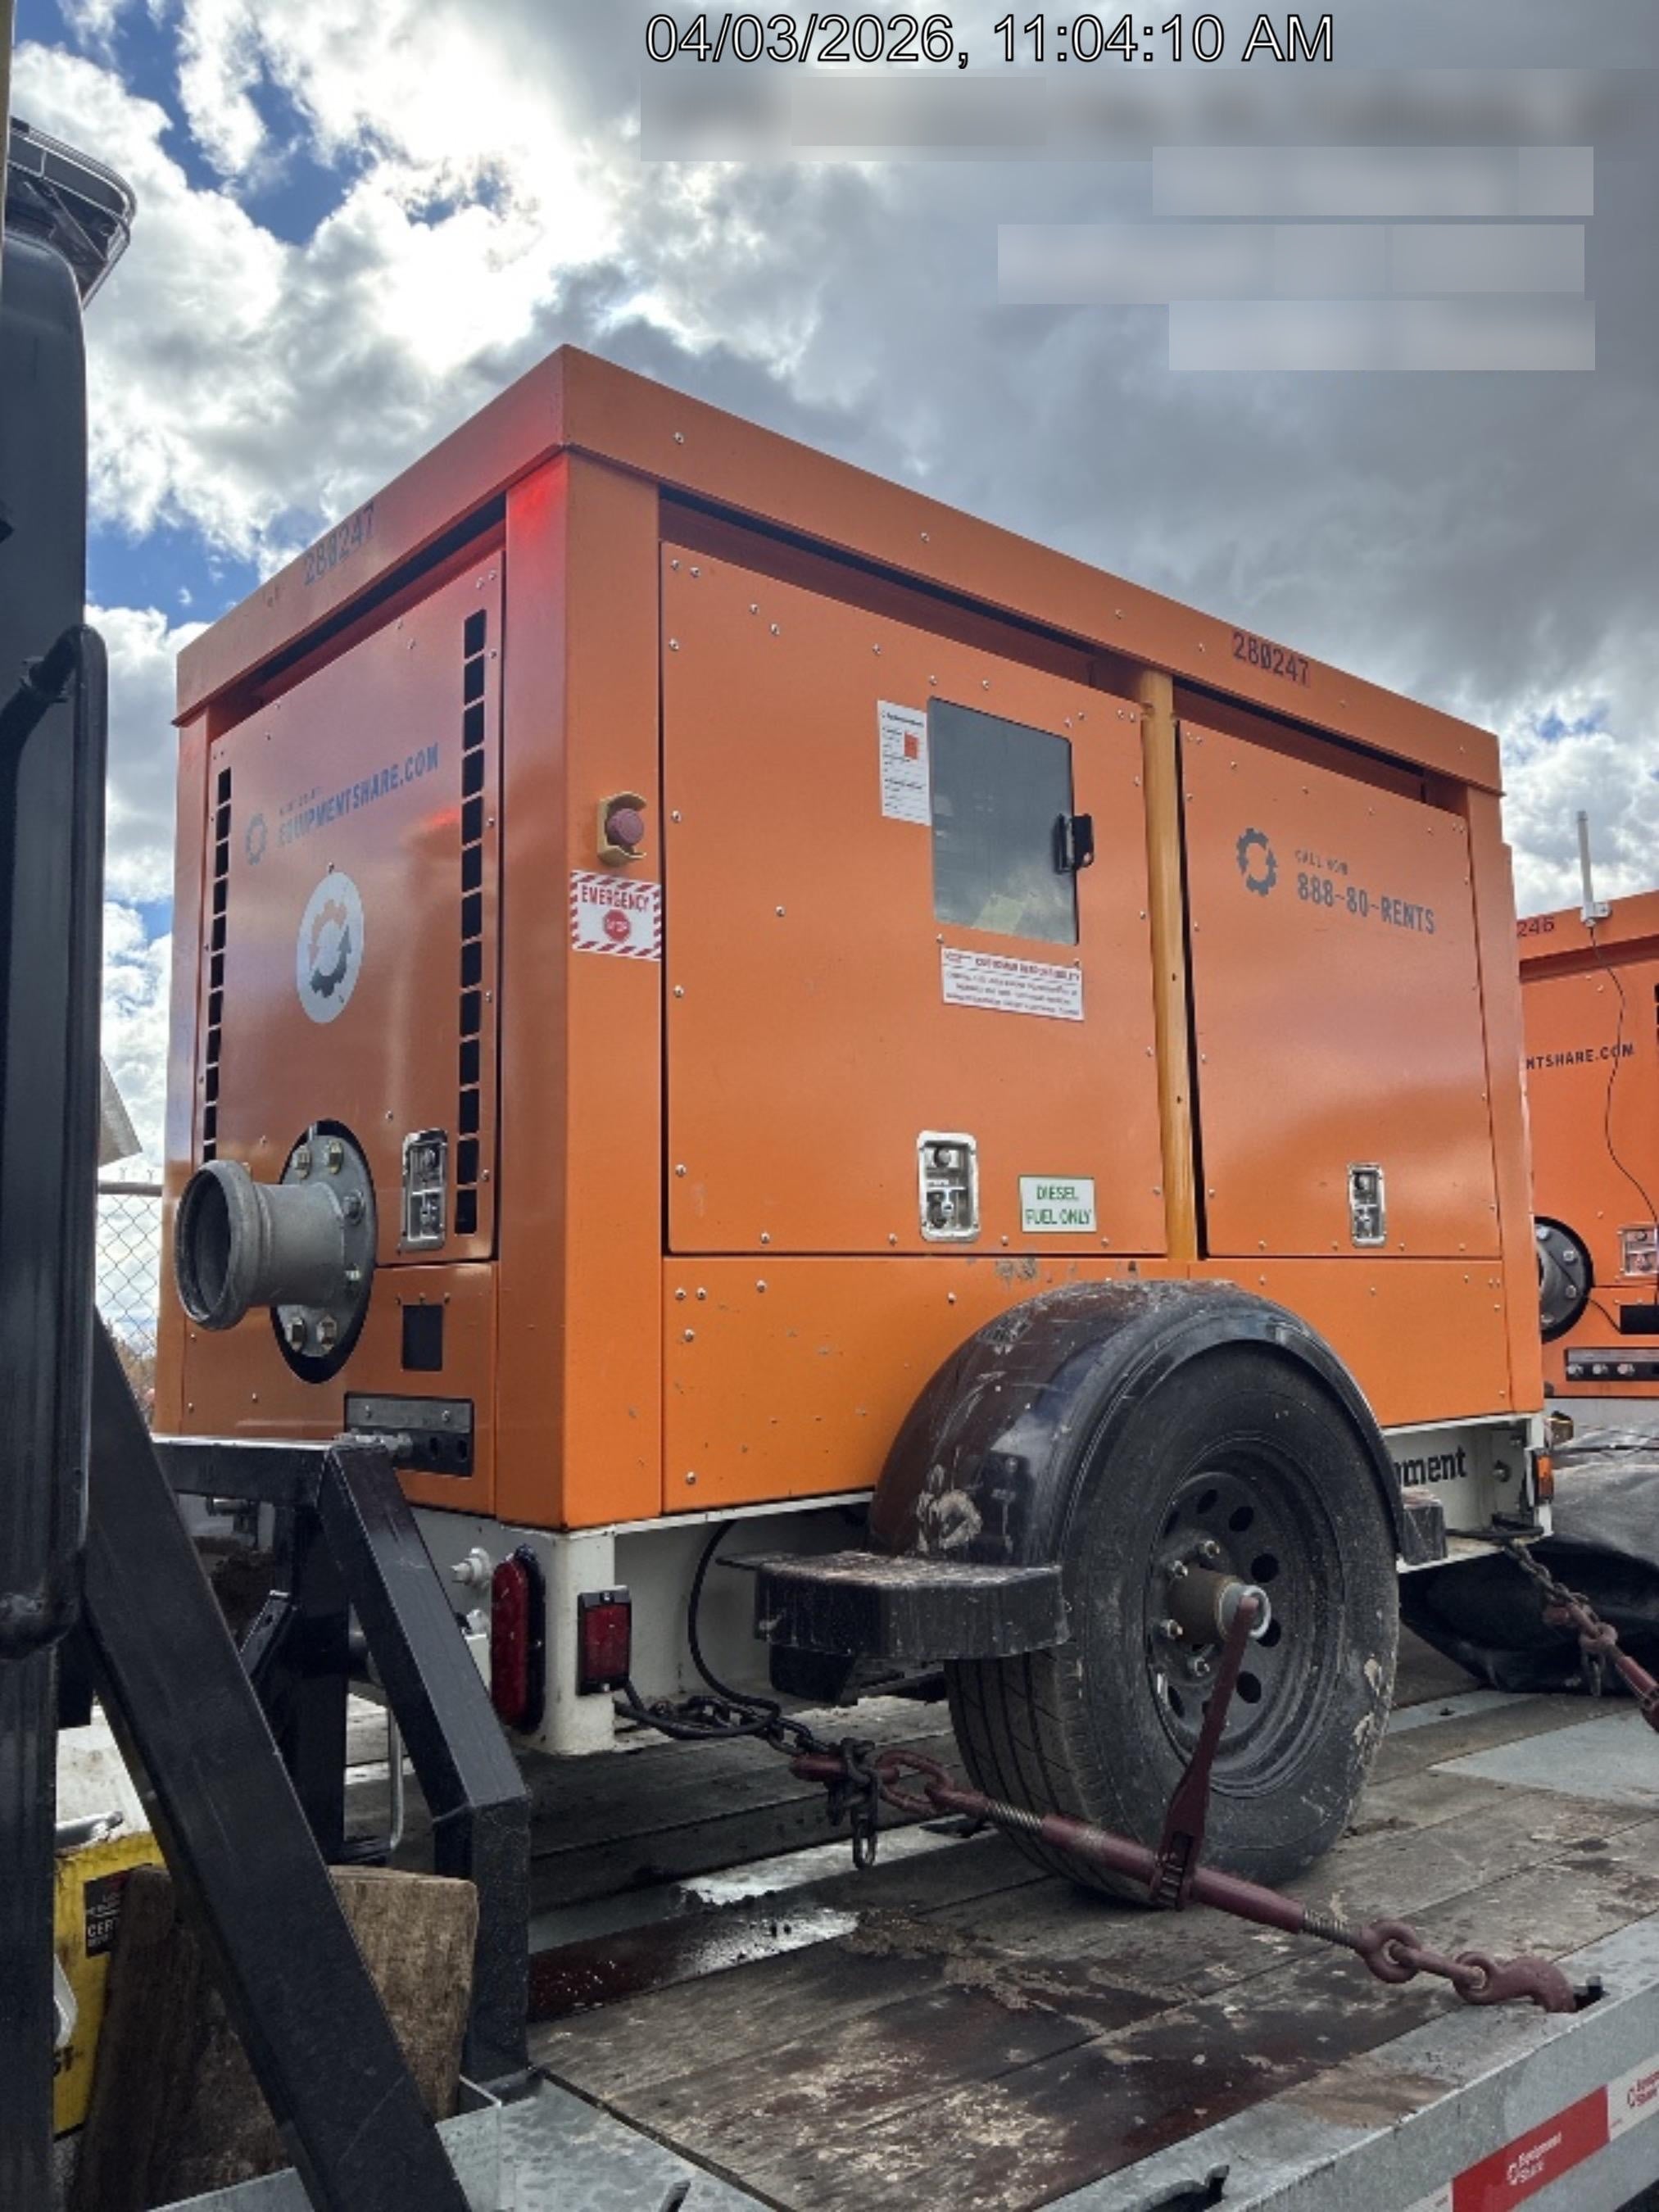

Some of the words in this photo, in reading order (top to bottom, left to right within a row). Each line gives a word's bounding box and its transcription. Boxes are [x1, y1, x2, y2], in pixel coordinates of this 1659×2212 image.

[1233, 630, 1308, 686] 280247
[582, 884, 650, 912] EMERGENCY
[1298, 873, 1435, 934] 888-80-RENTS
[1036, 1185, 1079, 1202] DIESEL
[1026, 1208, 1058, 1225] FUEL
[1060, 1208, 1092, 1225] ONLY
